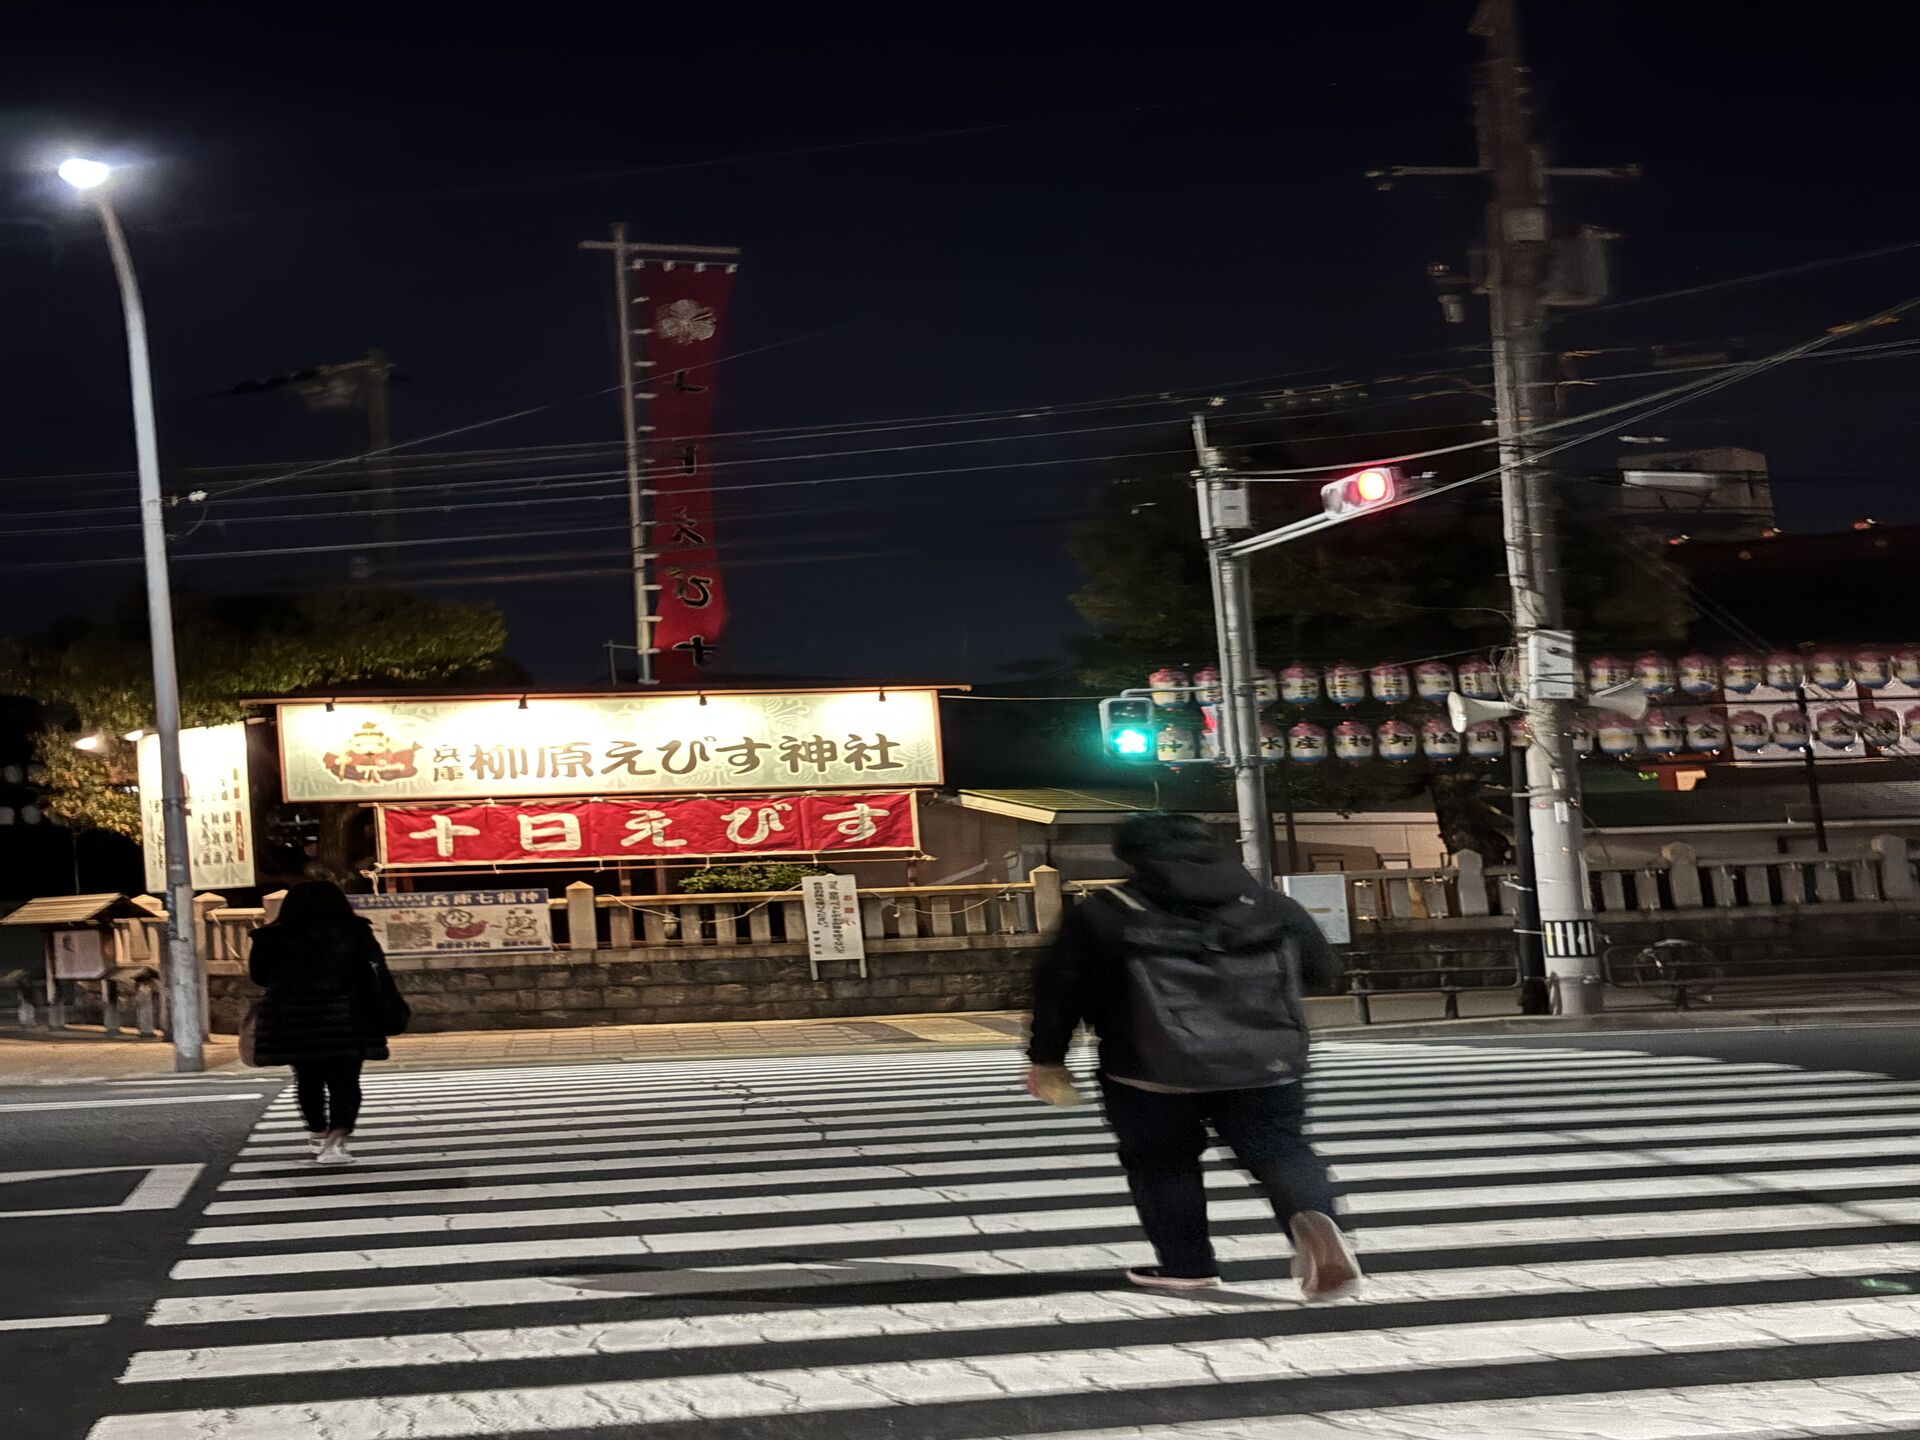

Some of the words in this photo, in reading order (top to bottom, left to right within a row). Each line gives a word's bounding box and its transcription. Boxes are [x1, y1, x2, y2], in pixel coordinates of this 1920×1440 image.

[470, 732, 904, 780] 柳原えびす神社
[409, 803, 889, 857] 十日えびす
